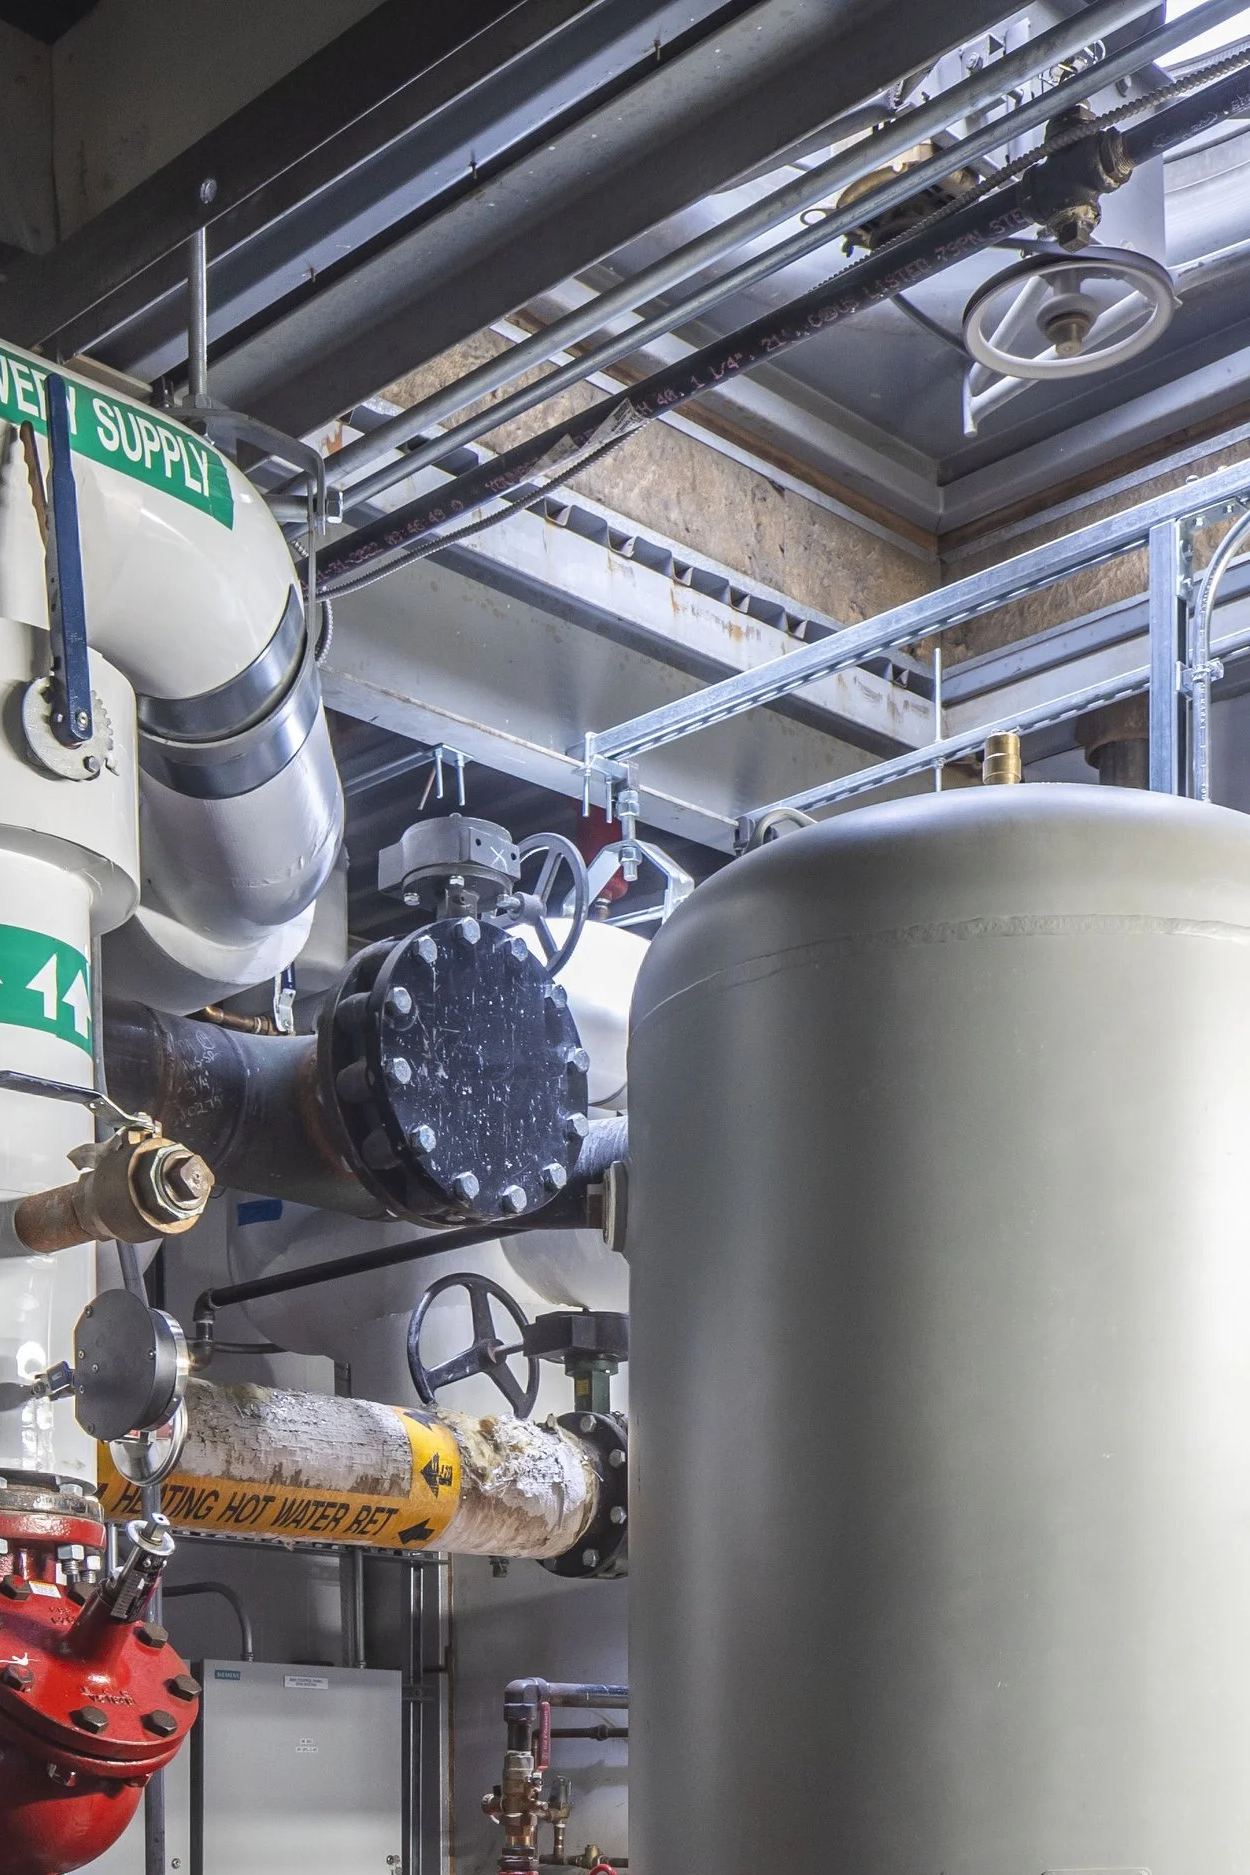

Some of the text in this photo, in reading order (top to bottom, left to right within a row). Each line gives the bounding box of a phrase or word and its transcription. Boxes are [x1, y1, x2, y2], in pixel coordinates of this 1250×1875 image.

[92, 397, 210, 498] SUPPLY
[223, 1494, 274, 1525] HOT
[271, 1498, 342, 1531] WATER
[343, 1506, 398, 1537] RET
